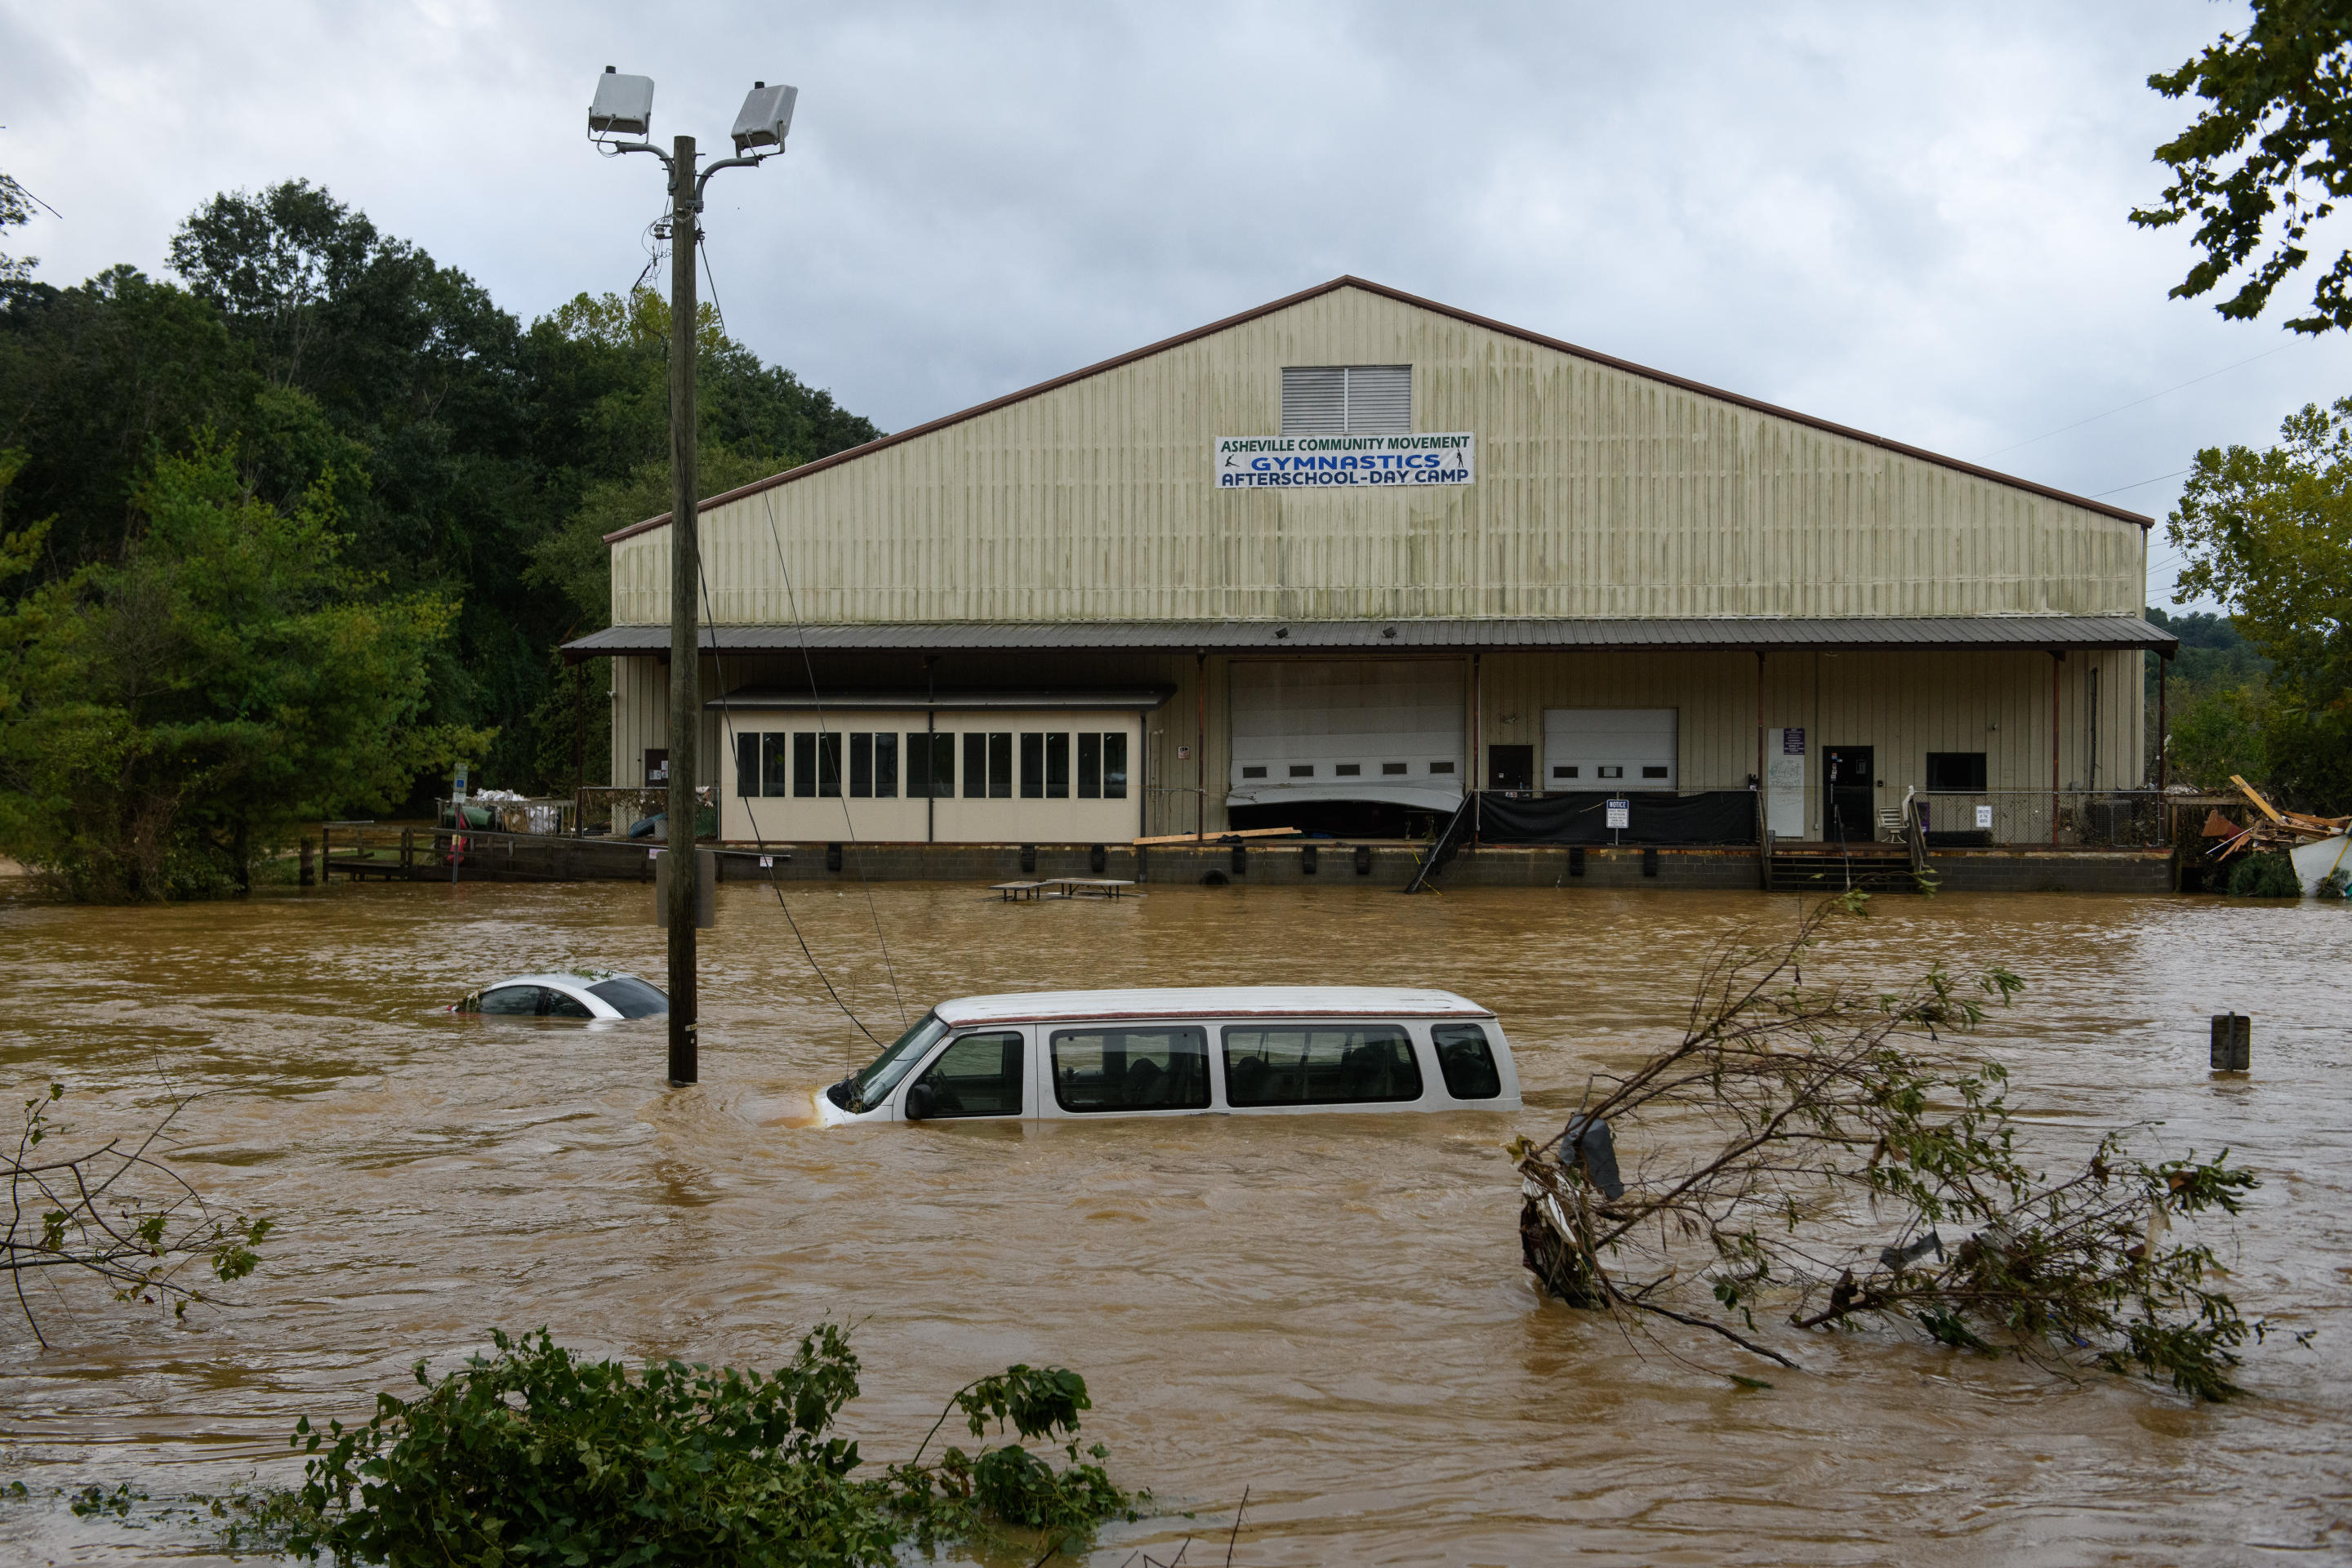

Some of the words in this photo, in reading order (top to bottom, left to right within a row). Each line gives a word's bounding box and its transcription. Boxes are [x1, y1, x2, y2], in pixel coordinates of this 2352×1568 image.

[1221, 439, 1295, 452] ASHEVILLE
[1298, 438, 1384, 451] COMMUNITY
[1387, 436, 1470, 449] MOVEMENT
[1251, 454, 1441, 471] GYMNASTICS
[1222, 470, 1410, 486] AFTERSCHOOL-DAY
[1414, 469, 1469, 483] CAMP
